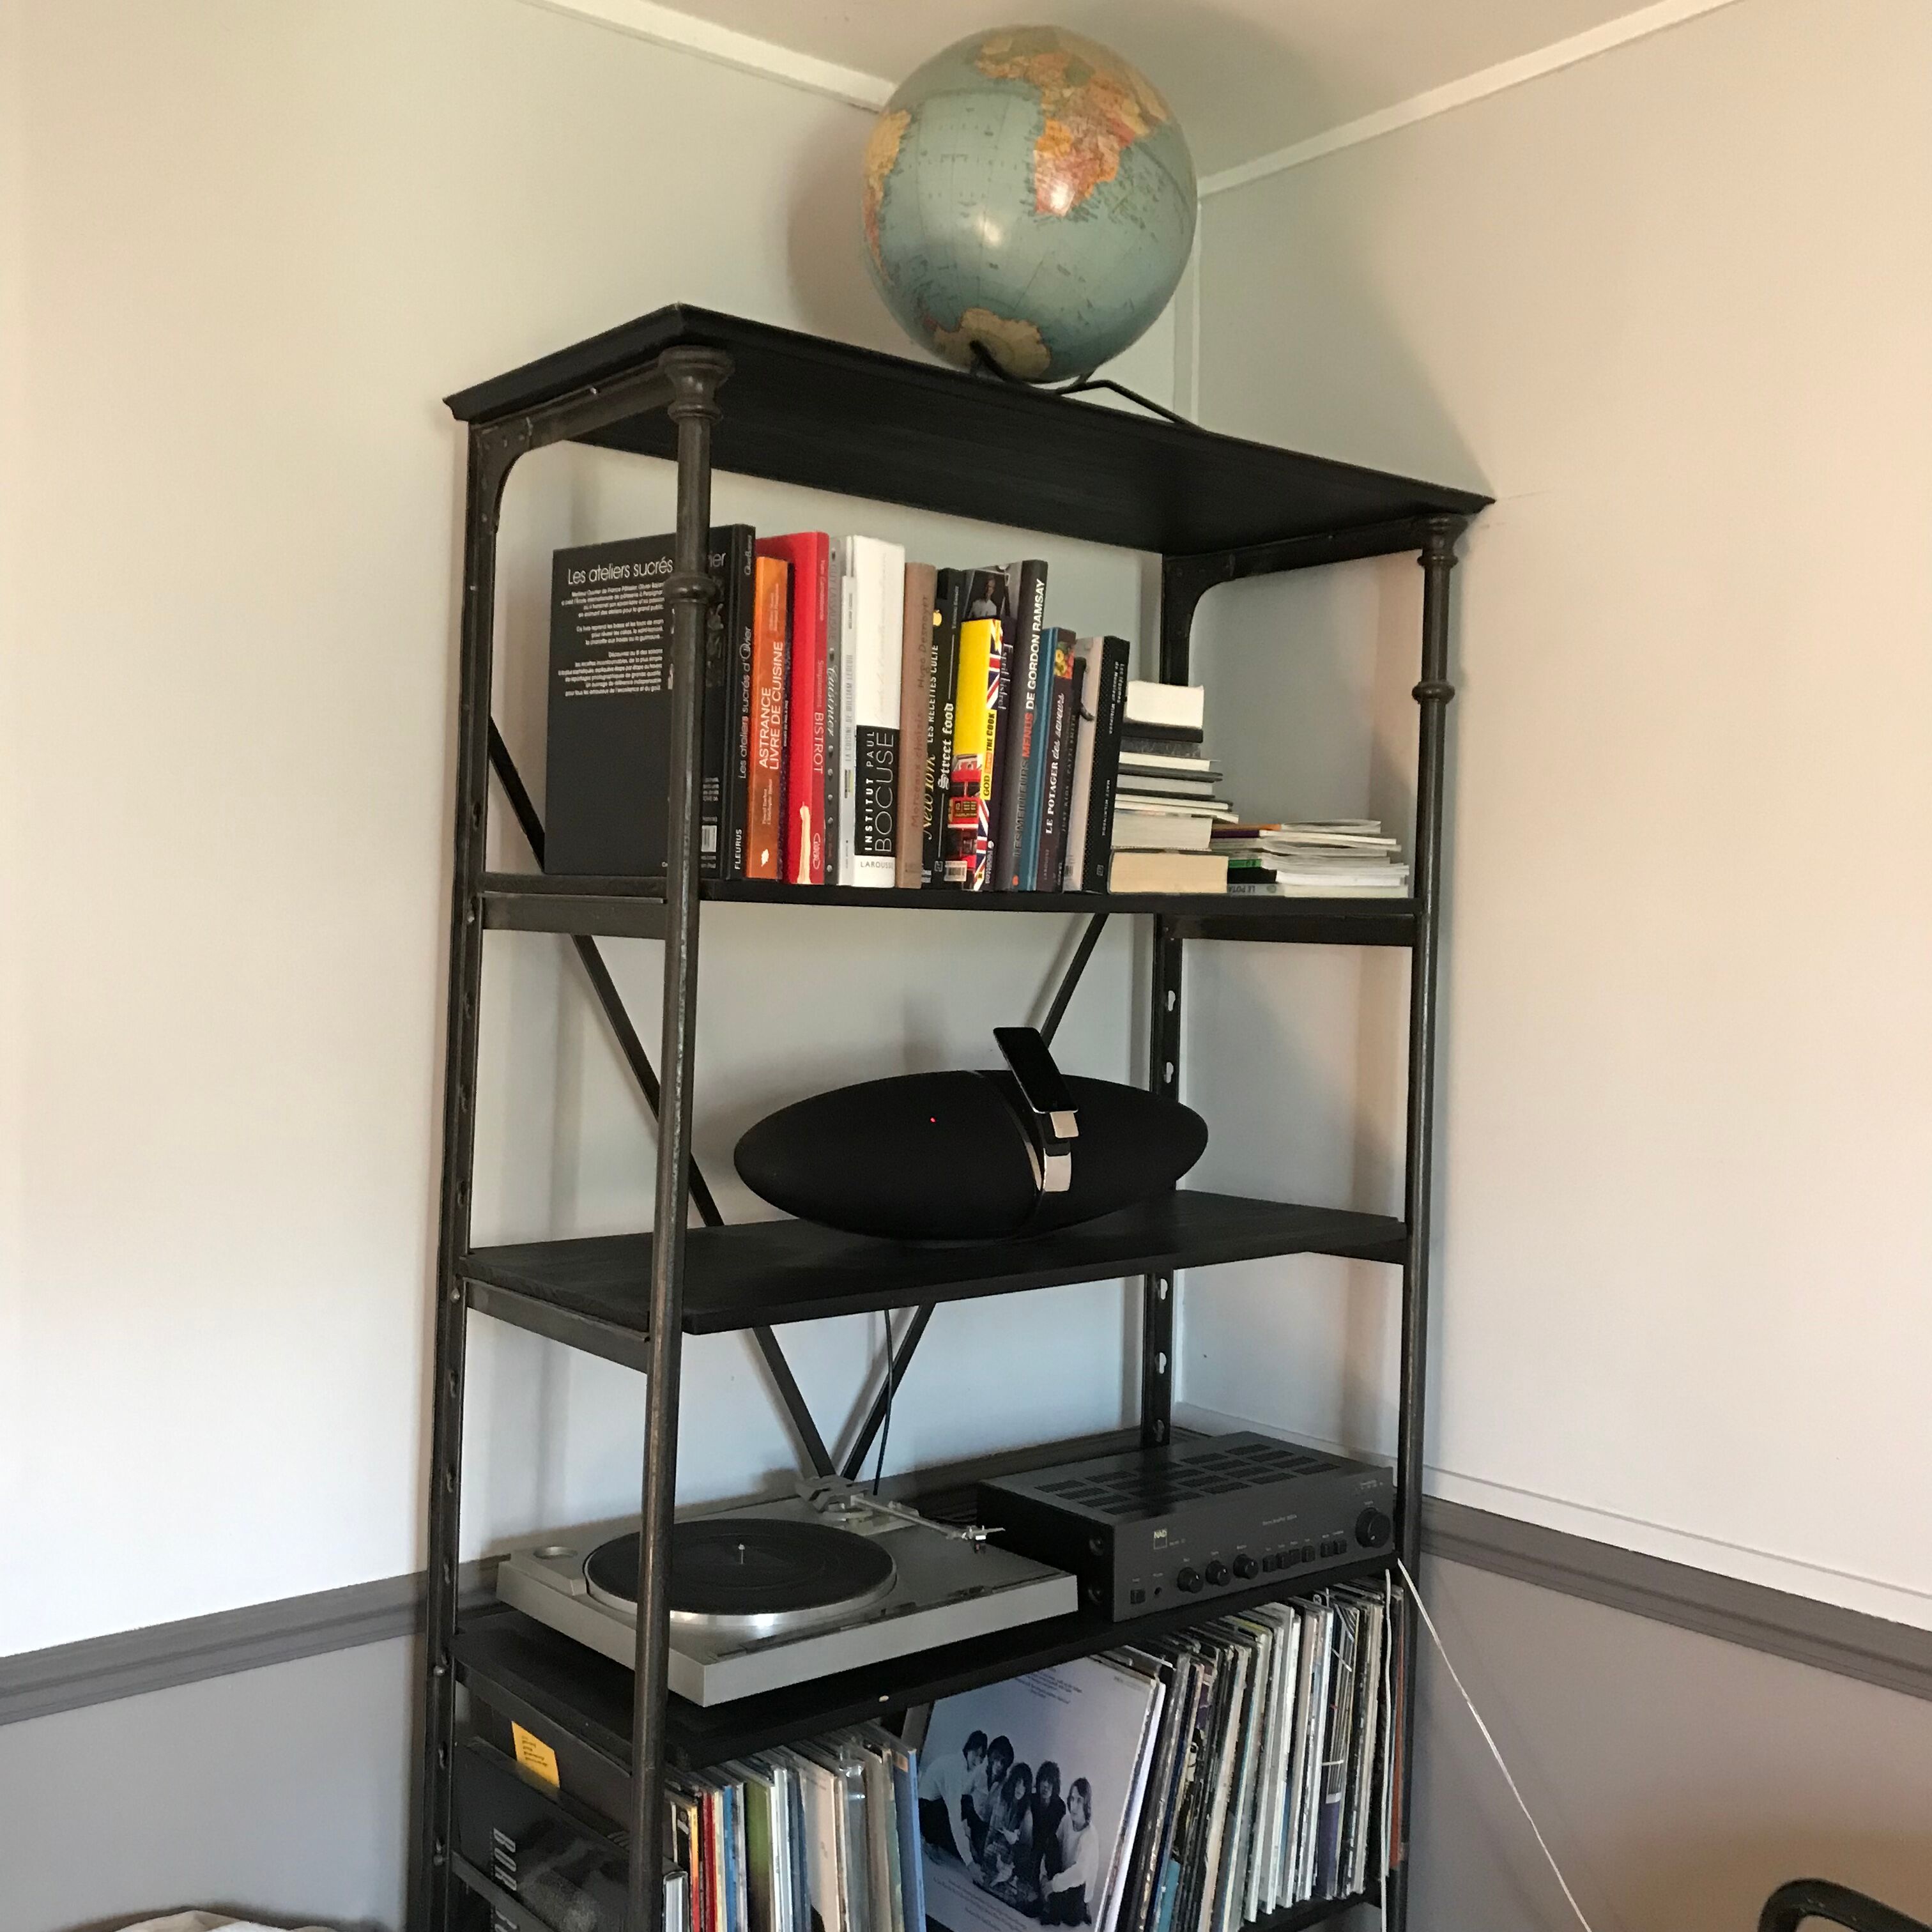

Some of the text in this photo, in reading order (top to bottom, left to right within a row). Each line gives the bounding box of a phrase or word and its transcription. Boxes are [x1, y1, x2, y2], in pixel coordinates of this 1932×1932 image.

[568, 556, 673, 585] Les ateliers sucrés
[741, 674, 750, 712] sucrés
[772, 641, 783, 702] CUISINE
[917, 658, 928, 689] Hugo
[998, 643, 1014, 710] Esprit bistrot
[759, 687, 771, 769] ASTRANCE
[771, 704, 781, 724] DE
[986, 712, 995, 736] COOK
[1013, 578, 1045, 857] LES MEILLEURS MENUS DE GORDON RAMSAY
[1054, 693, 1065, 737] saveurs
[740, 716, 748, 759] ateliers
[769, 729, 780, 770] LIVRE
[813, 712, 824, 774] BISTROT
[937, 702, 954, 790] Street food
[1052, 740, 1061, 759] des
[738, 760, 746, 779] Les
[865, 731, 875, 850] INSTITUT PAUL
[1047, 762, 1058, 815] POTAGER
[875, 732, 894, 852] BOCUSE
[1045, 818, 1054, 834] LE
